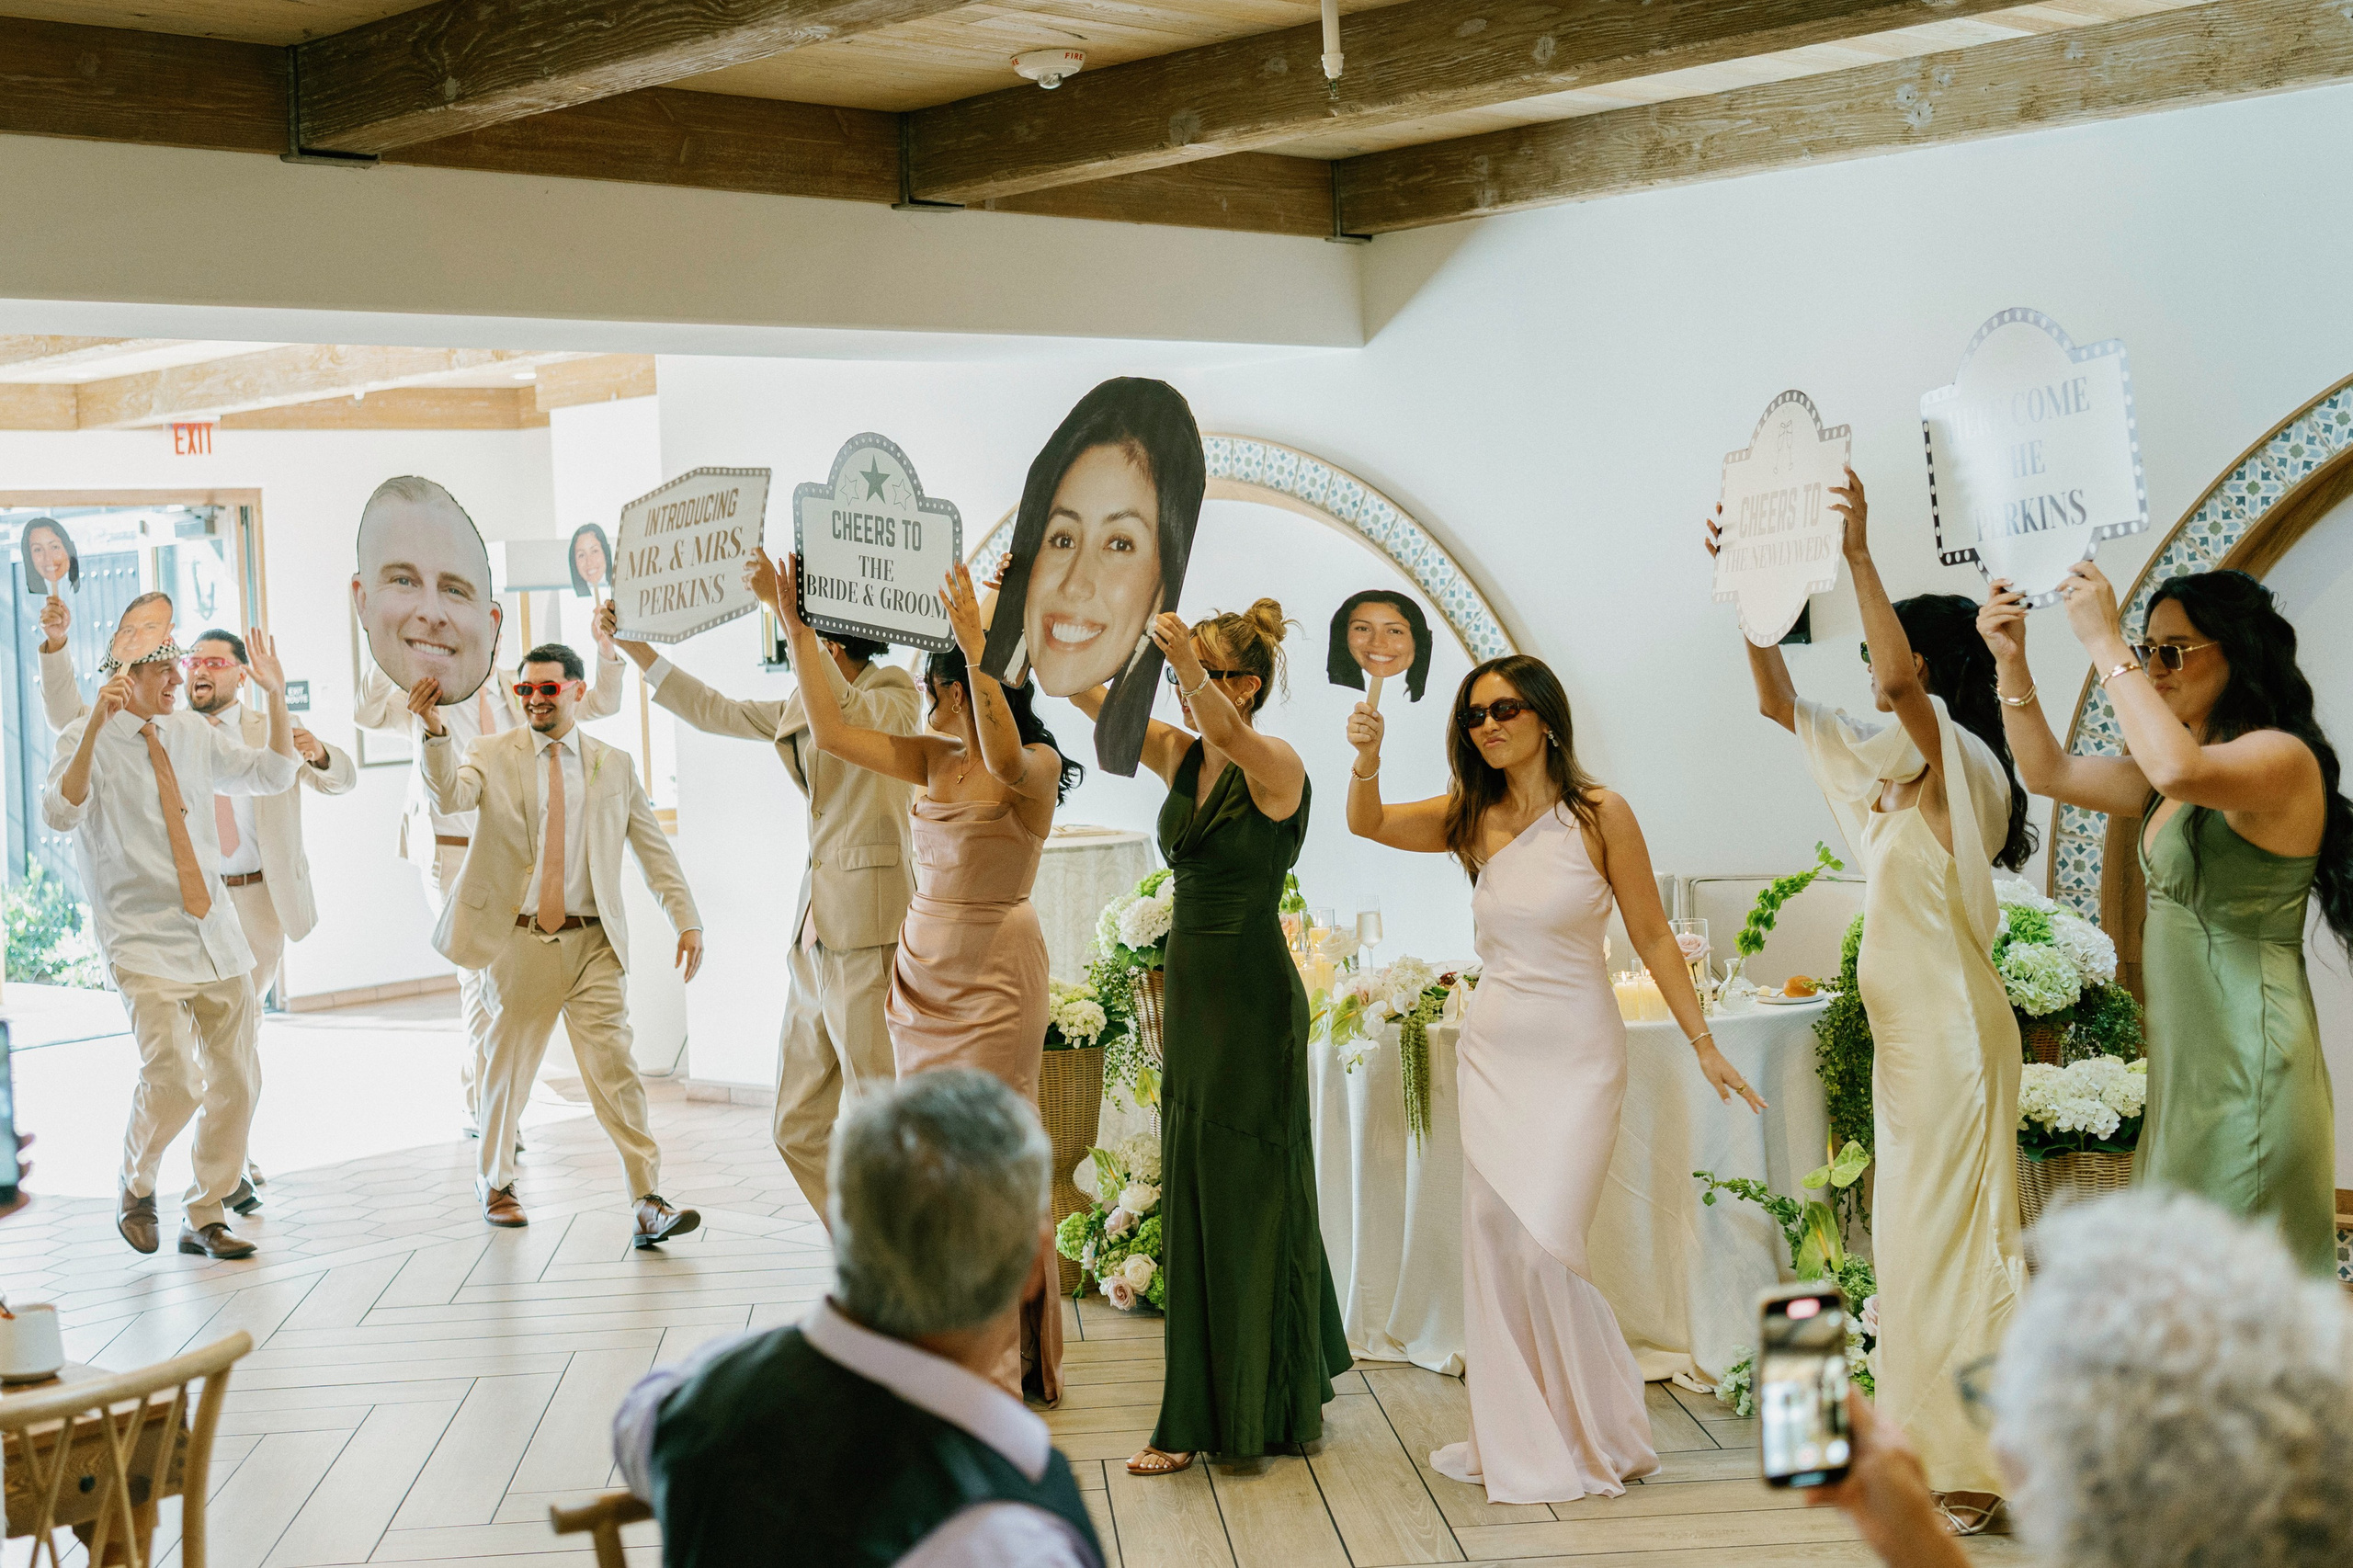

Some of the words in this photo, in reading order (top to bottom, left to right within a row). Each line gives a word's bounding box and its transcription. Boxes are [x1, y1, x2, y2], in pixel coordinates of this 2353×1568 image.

[1064, 52, 1083, 61] FIRE
[172, 422, 213, 455] EXIT
[2004, 439, 2046, 479] HE
[644, 487, 739, 538] INTRODUCING
[832, 509, 896, 548] CHEERS
[902, 519, 922, 551] TO
[1738, 487, 1798, 540] CHEERS
[1802, 482, 1822, 528] TO
[625, 546, 664, 582] MR.
[669, 539, 685, 572] &
[690, 526, 746, 567] MRS.
[858, 554, 894, 582] THE
[1724, 547, 1749, 574] THE
[1750, 534, 1832, 572] NEWLYWEDS
[638, 574, 726, 619] PERKINS
[806, 574, 858, 604] BRIDE
[862, 583, 875, 607] &
[880, 585, 948, 620] GROOM
